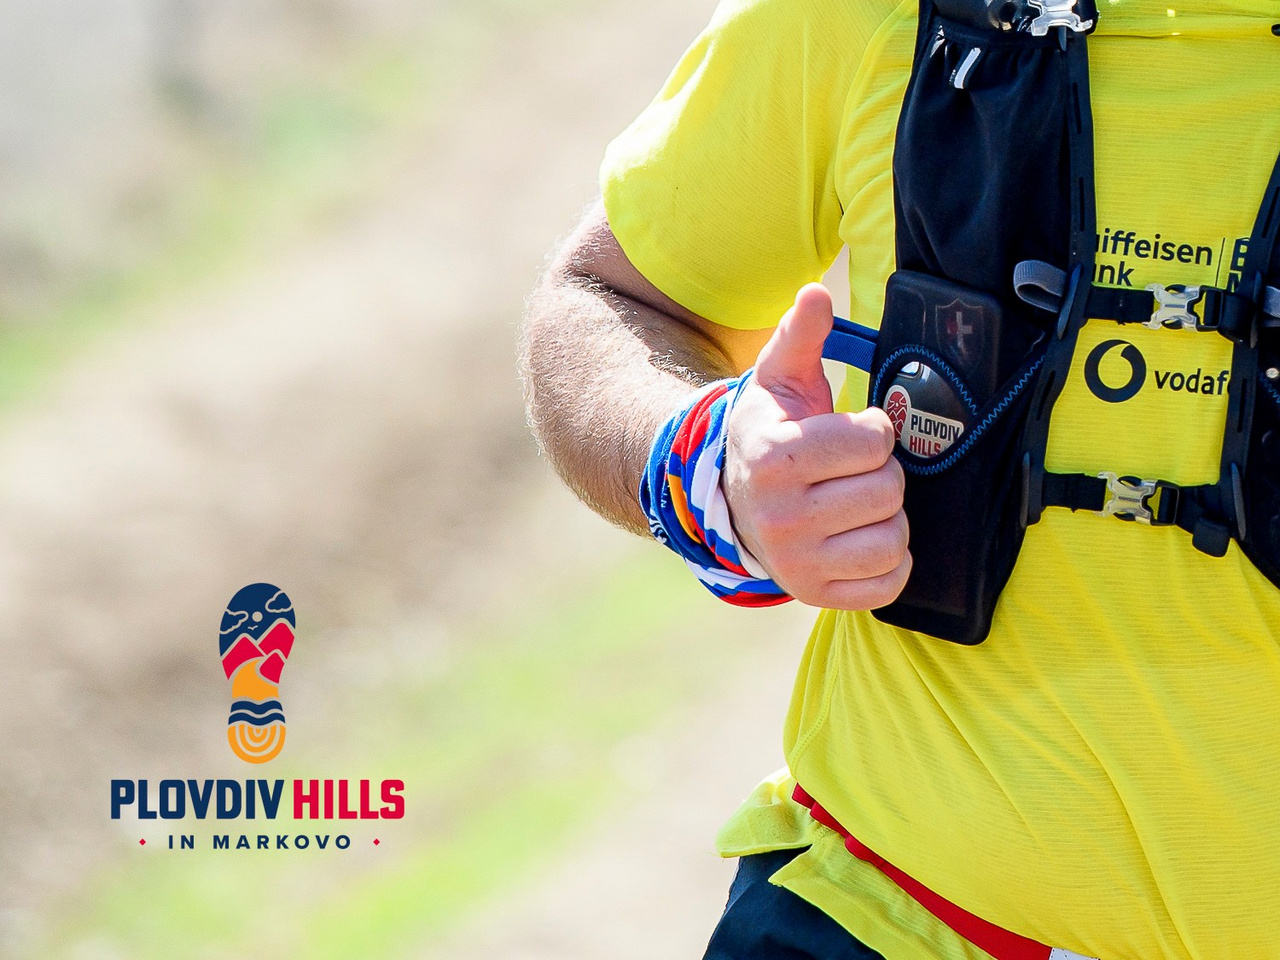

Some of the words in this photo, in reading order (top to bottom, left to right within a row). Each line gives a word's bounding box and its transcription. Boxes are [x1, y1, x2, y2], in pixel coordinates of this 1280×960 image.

[1095, 227, 1212, 266] iffeisen
[1092, 260, 1135, 287] nk
[1154, 367, 1230, 396] vodaf
[910, 413, 960, 443] PLOVDIV
[909, 434, 942, 457] HILLS
